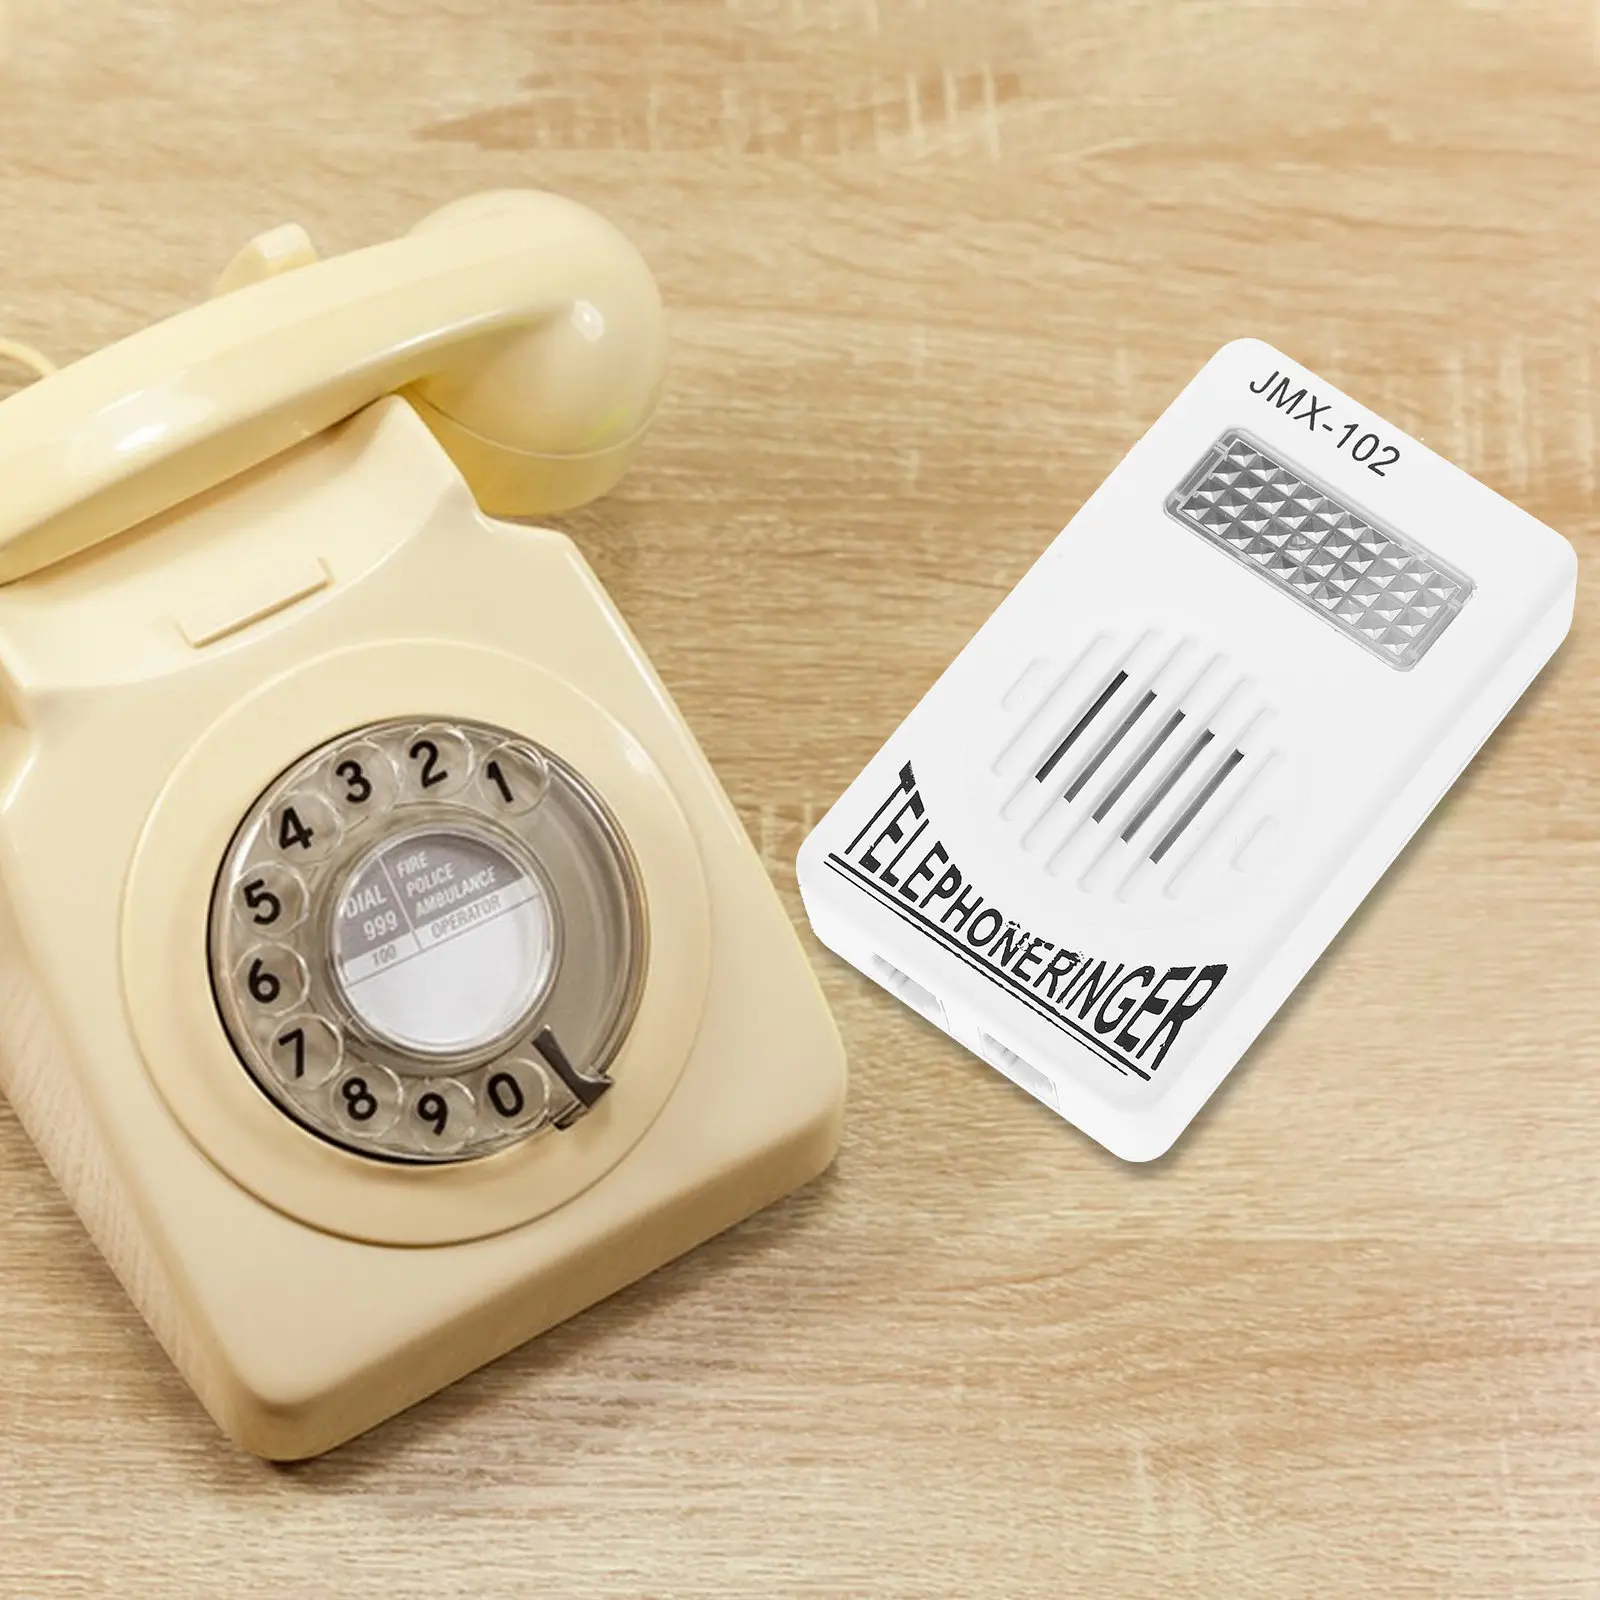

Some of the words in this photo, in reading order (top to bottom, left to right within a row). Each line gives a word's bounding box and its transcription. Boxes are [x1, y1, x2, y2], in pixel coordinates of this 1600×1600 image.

[1249, 371, 1400, 477] JMX-102
[335, 760, 373, 804] 3
[409, 740, 448, 788] 2
[486, 760, 515, 803] 1
[278, 807, 315, 852] 4
[396, 852, 429, 879] FIRE
[405, 862, 455, 898] POLICE
[243, 878, 282, 925] 5
[343, 884, 388, 920] DIAL
[415, 865, 497, 918] AMBULANCE
[363, 909, 399, 941] 999
[429, 894, 502, 938] OPERATOR
[372, 944, 397, 967] 100
[247, 959, 281, 1004] 6
[278, 1027, 305, 1078] 7
[342, 1076, 378, 1121] 8
[417, 1092, 450, 1136] 9
[487, 1072, 525, 1118] 0
